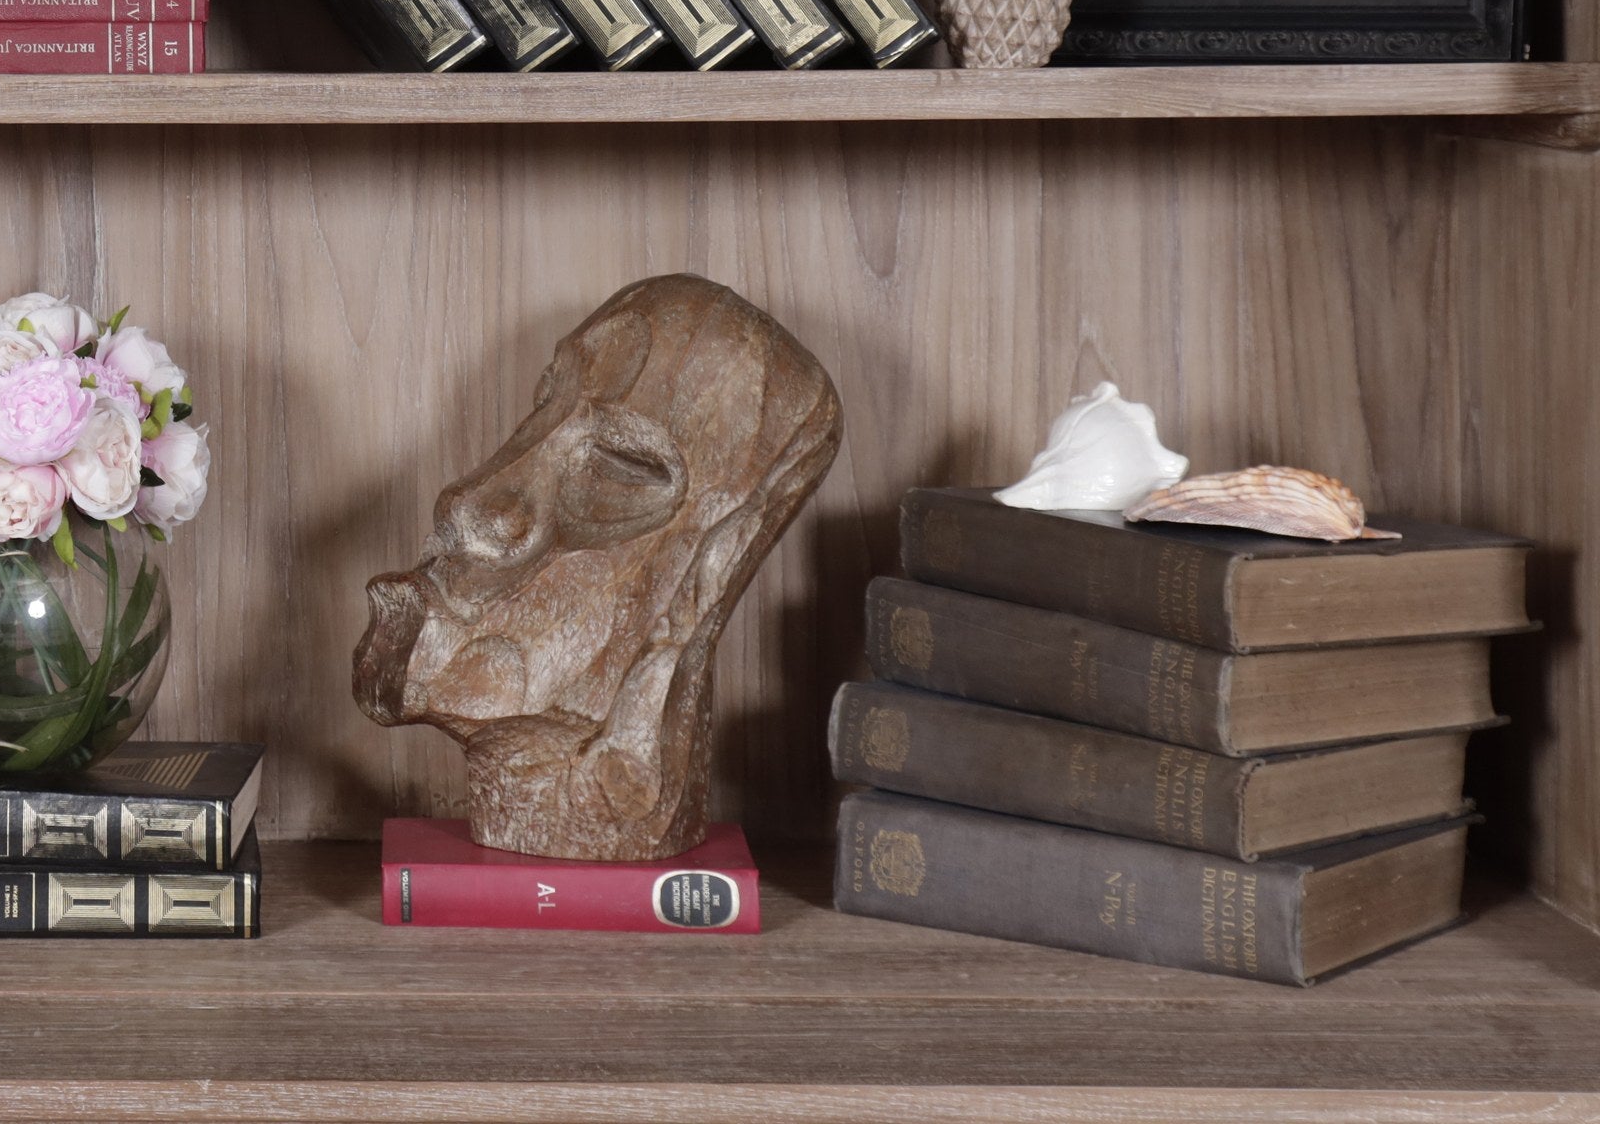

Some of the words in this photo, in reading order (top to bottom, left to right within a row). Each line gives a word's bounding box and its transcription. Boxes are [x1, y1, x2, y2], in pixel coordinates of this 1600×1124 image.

[114, 32, 122, 63] ATLAS
[126, 25, 134, 51] READING
[137, 32, 147, 66] WXYZ
[164, 40, 178, 56] 15
[126, 51, 134, 71] GUIDE
[853, 821, 865, 893] OXFORD
[537, 882, 556, 915] A-L
[1100, 870, 1122, 931] N-Poy
[1243, 874, 1257, 907] THE
[1201, 867, 1218, 965] DICTIONARY
[1221, 870, 1238, 969] ENGLISH
[1242, 909, 1258, 973] OXFORD
